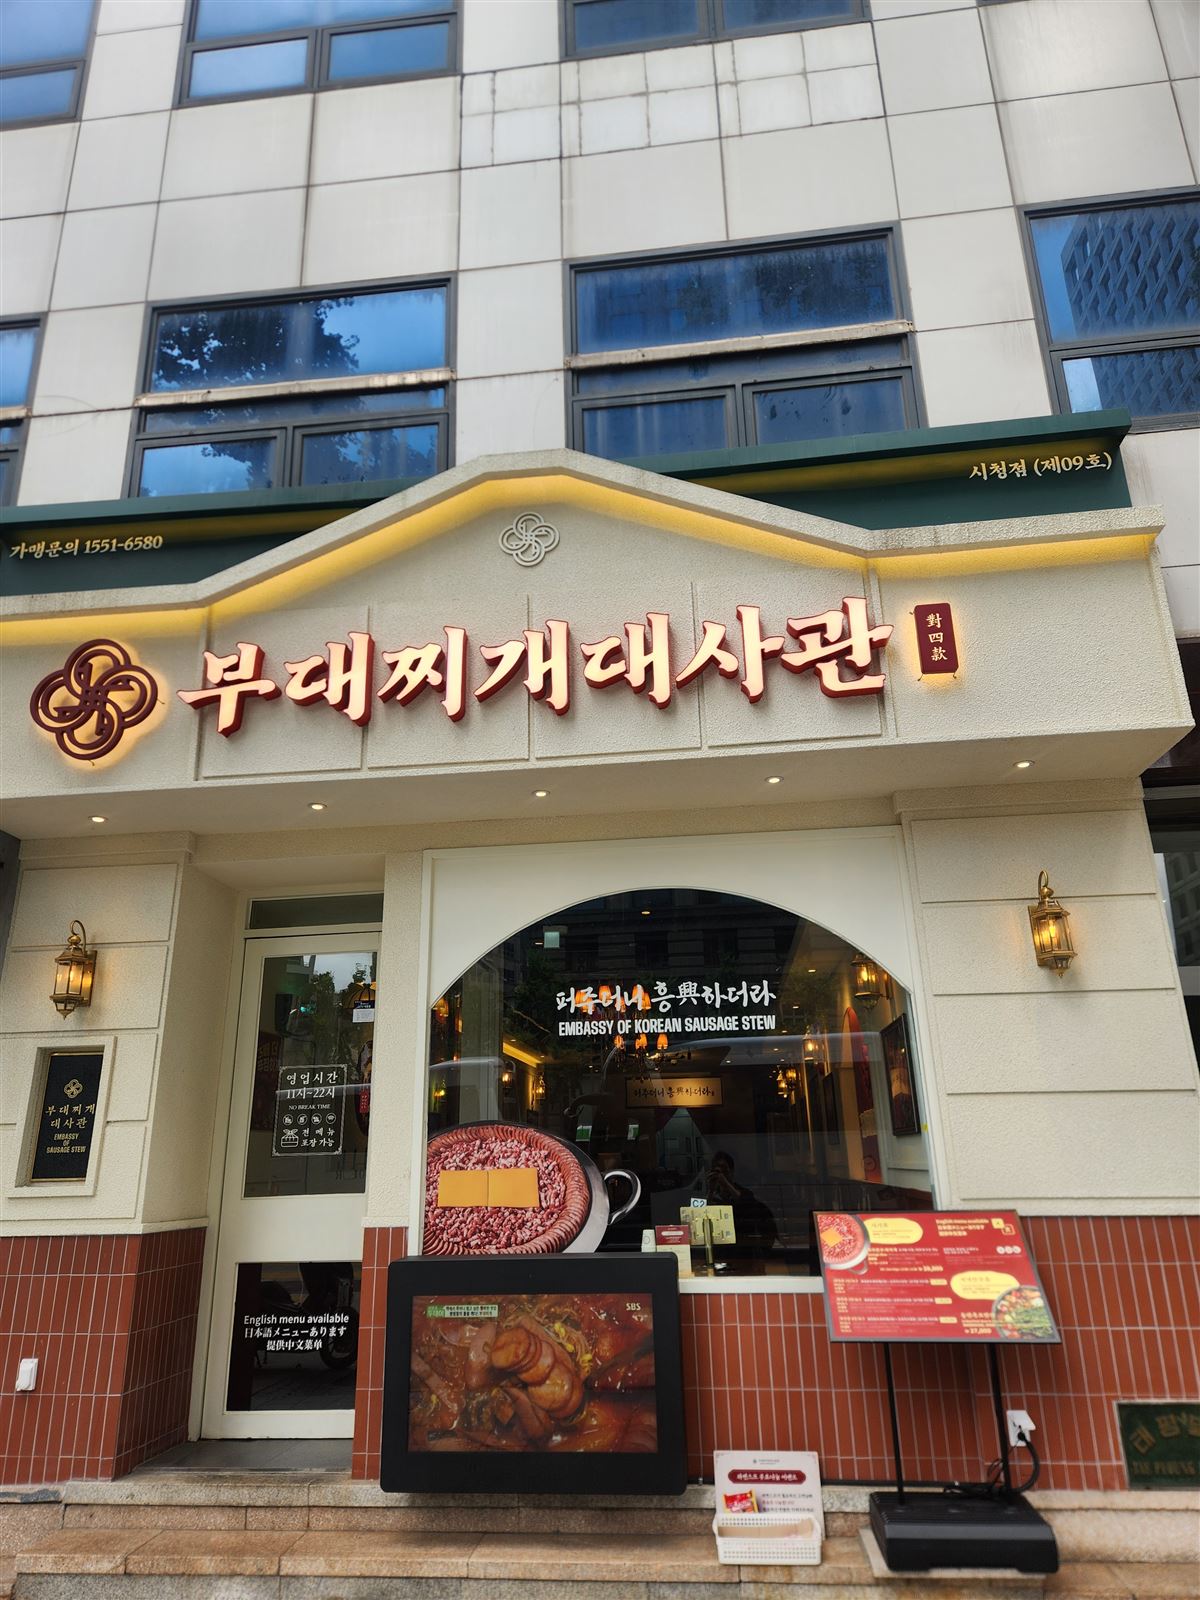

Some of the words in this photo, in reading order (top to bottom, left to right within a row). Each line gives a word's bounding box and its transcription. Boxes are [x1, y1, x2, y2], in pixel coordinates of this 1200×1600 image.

[969, 459, 1027, 481] 시청점
[1033, 452, 1113, 476] (제09호)
[9, 539, 80, 560] 가맹문의
[83, 535, 163, 554] 1551-6580
[926, 613, 948, 661] 對四款
[177, 596, 894, 737] 부대찌개대사관
[556, 984, 643, 1015] 퍼주더니
[559, 1020, 613, 1036] EMBASSY
[617, 1019, 632, 1034] OF
[634, 1018, 682, 1034] KOREAN
[684, 1016, 739, 1031] SAUSAGE
[742, 1015, 776, 1030] STEW
[286, 1071, 338, 1085] 영업시간
[287, 1087, 335, 1099] 11시~22시
[45, 1104, 95, 1116] 부대찌개
[51, 1117, 87, 1129] 대사관
[301, 1138, 317, 1147] 포장
[319, 1137, 335, 1147] 가능
[46, 1146, 70, 1154] SAUSAGE
[71, 1145, 86, 1153] STEW
[244, 1314, 278, 1327] English
[279, 1315, 306, 1324] menu
[307, 1313, 350, 1324] available
[244, 1326, 347, 1339] 日本語メニューあります
